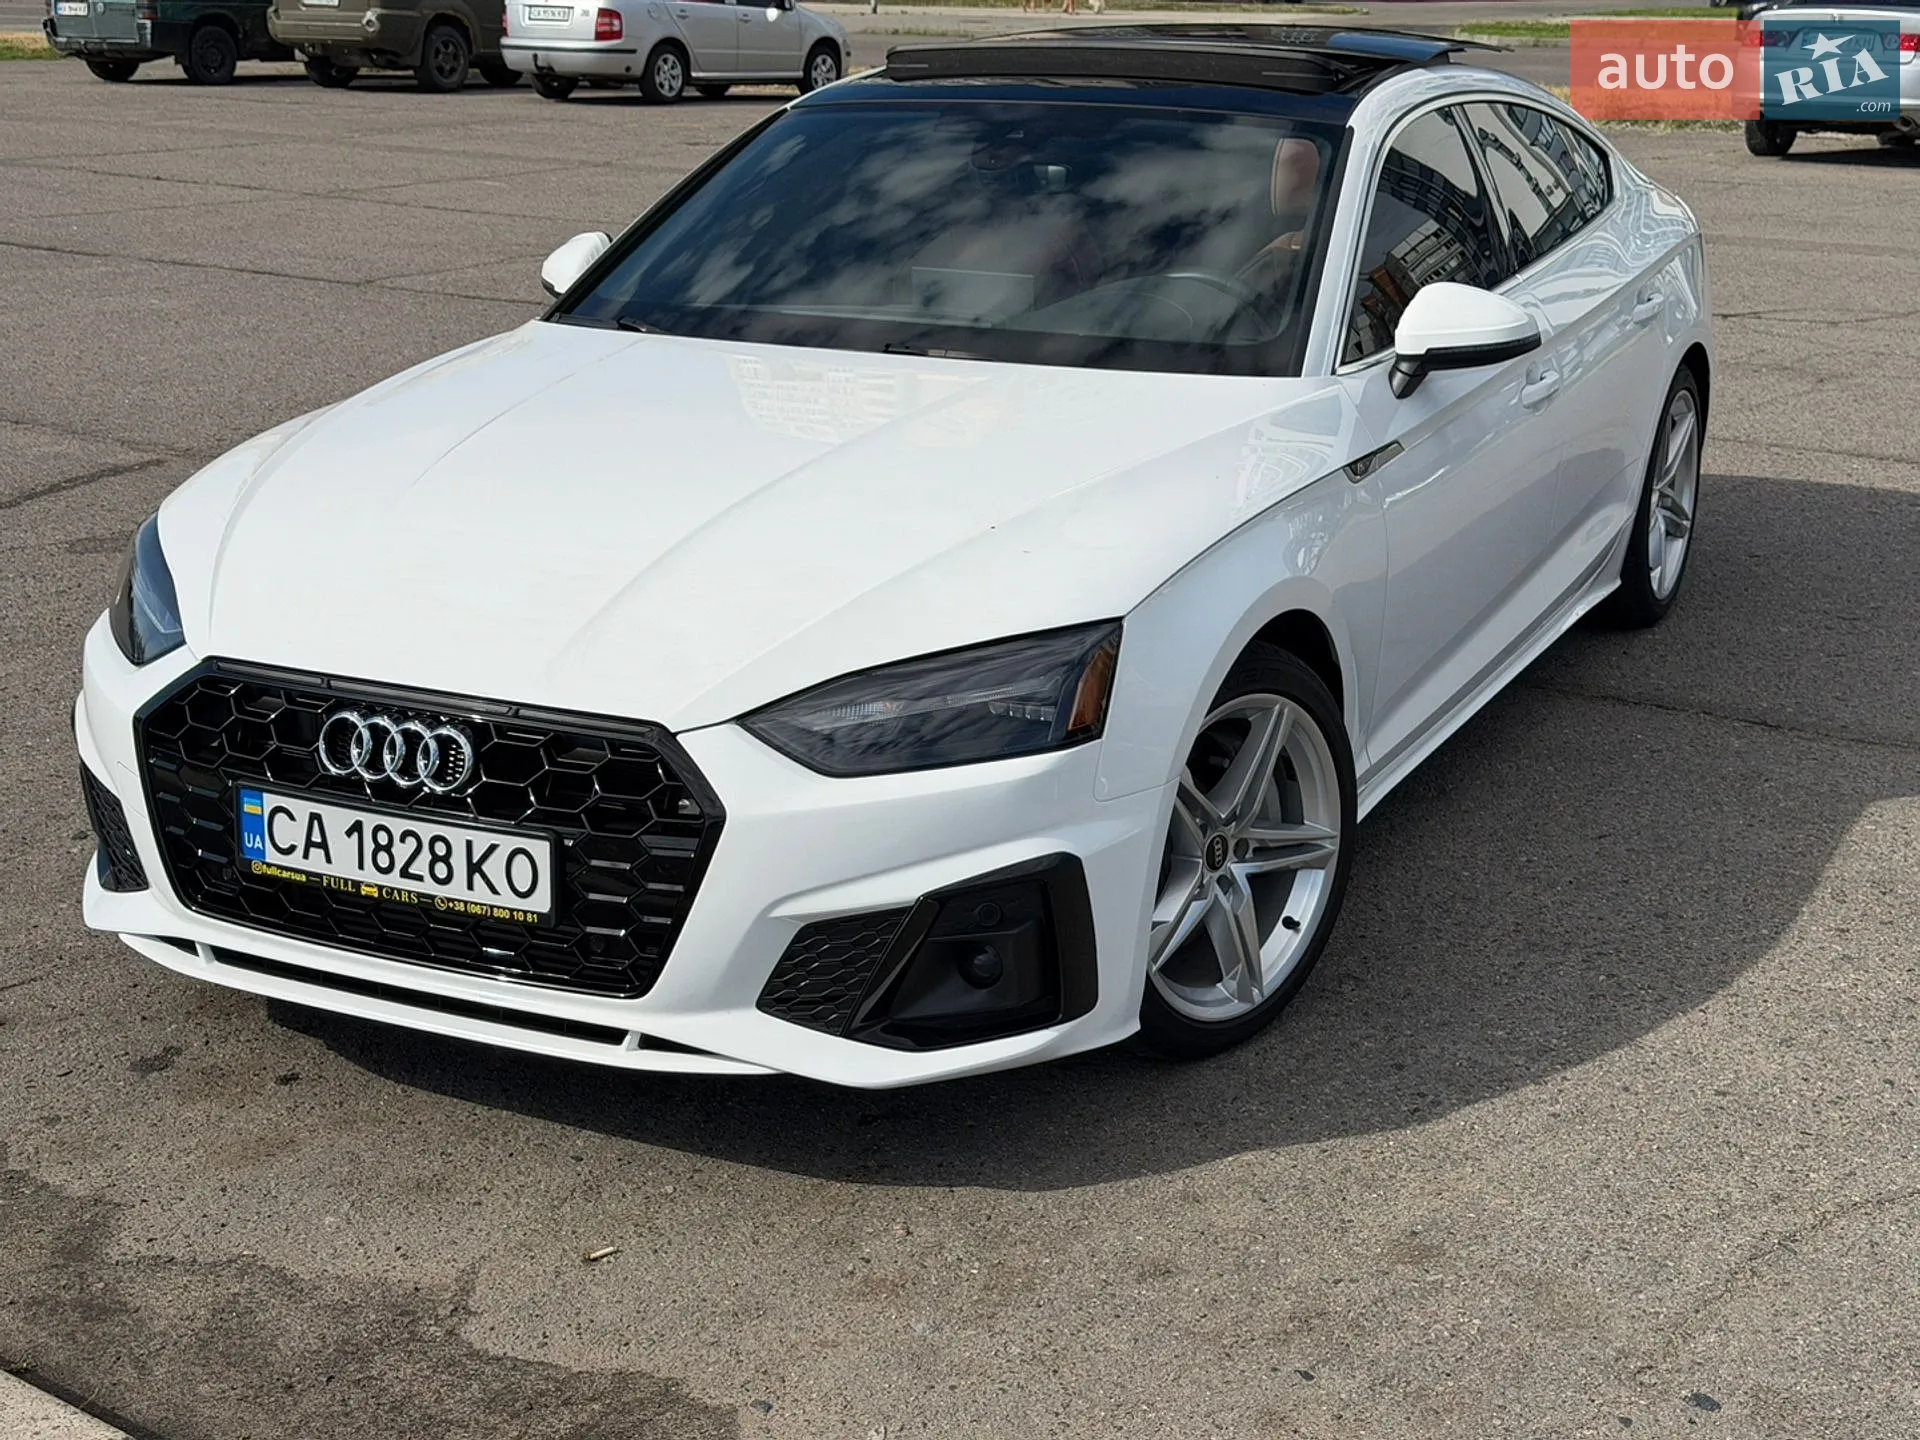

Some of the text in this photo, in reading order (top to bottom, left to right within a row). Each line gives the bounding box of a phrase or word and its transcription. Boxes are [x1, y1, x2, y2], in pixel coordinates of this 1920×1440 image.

[244, 831, 264, 851] UA
[267, 805, 539, 899] CA 1828 KO
[322, 875, 418, 904] FULL CARS
[447, 901, 538, 923] +38 (067) 800 10 81
